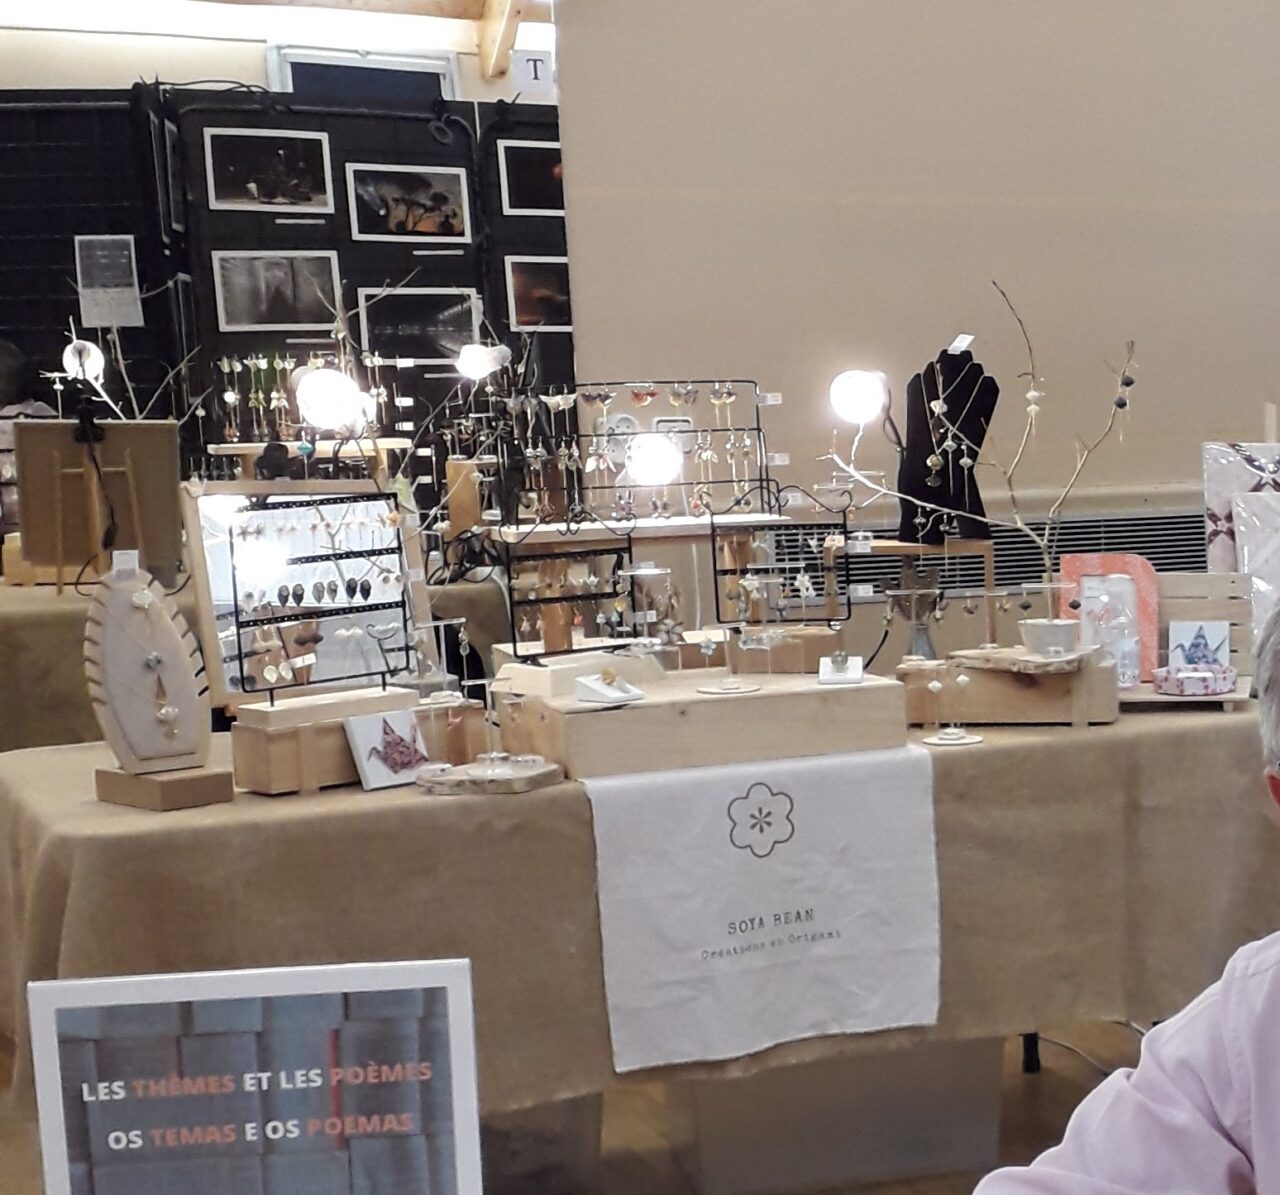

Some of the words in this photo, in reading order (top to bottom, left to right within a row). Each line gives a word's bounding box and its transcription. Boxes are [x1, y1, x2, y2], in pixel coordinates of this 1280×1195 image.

[526, 58, 544, 80] T
[728, 916, 765, 935] SOYA
[773, 908, 814, 927] BEAN
[788, 931, 842, 943] Origami
[81, 1081, 126, 1101] LES
[132, 1072, 235, 1098] THÈMES
[243, 1072, 272, 1091] ET
[279, 1069, 323, 1089] LES
[330, 1061, 432, 1086] POÈMES
[108, 1130, 143, 1150] OS
[151, 1124, 237, 1147] TEMAS
[244, 1123, 258, 1141] E
[265, 1119, 300, 1140] OS
[306, 1112, 413, 1137] POEMAS
